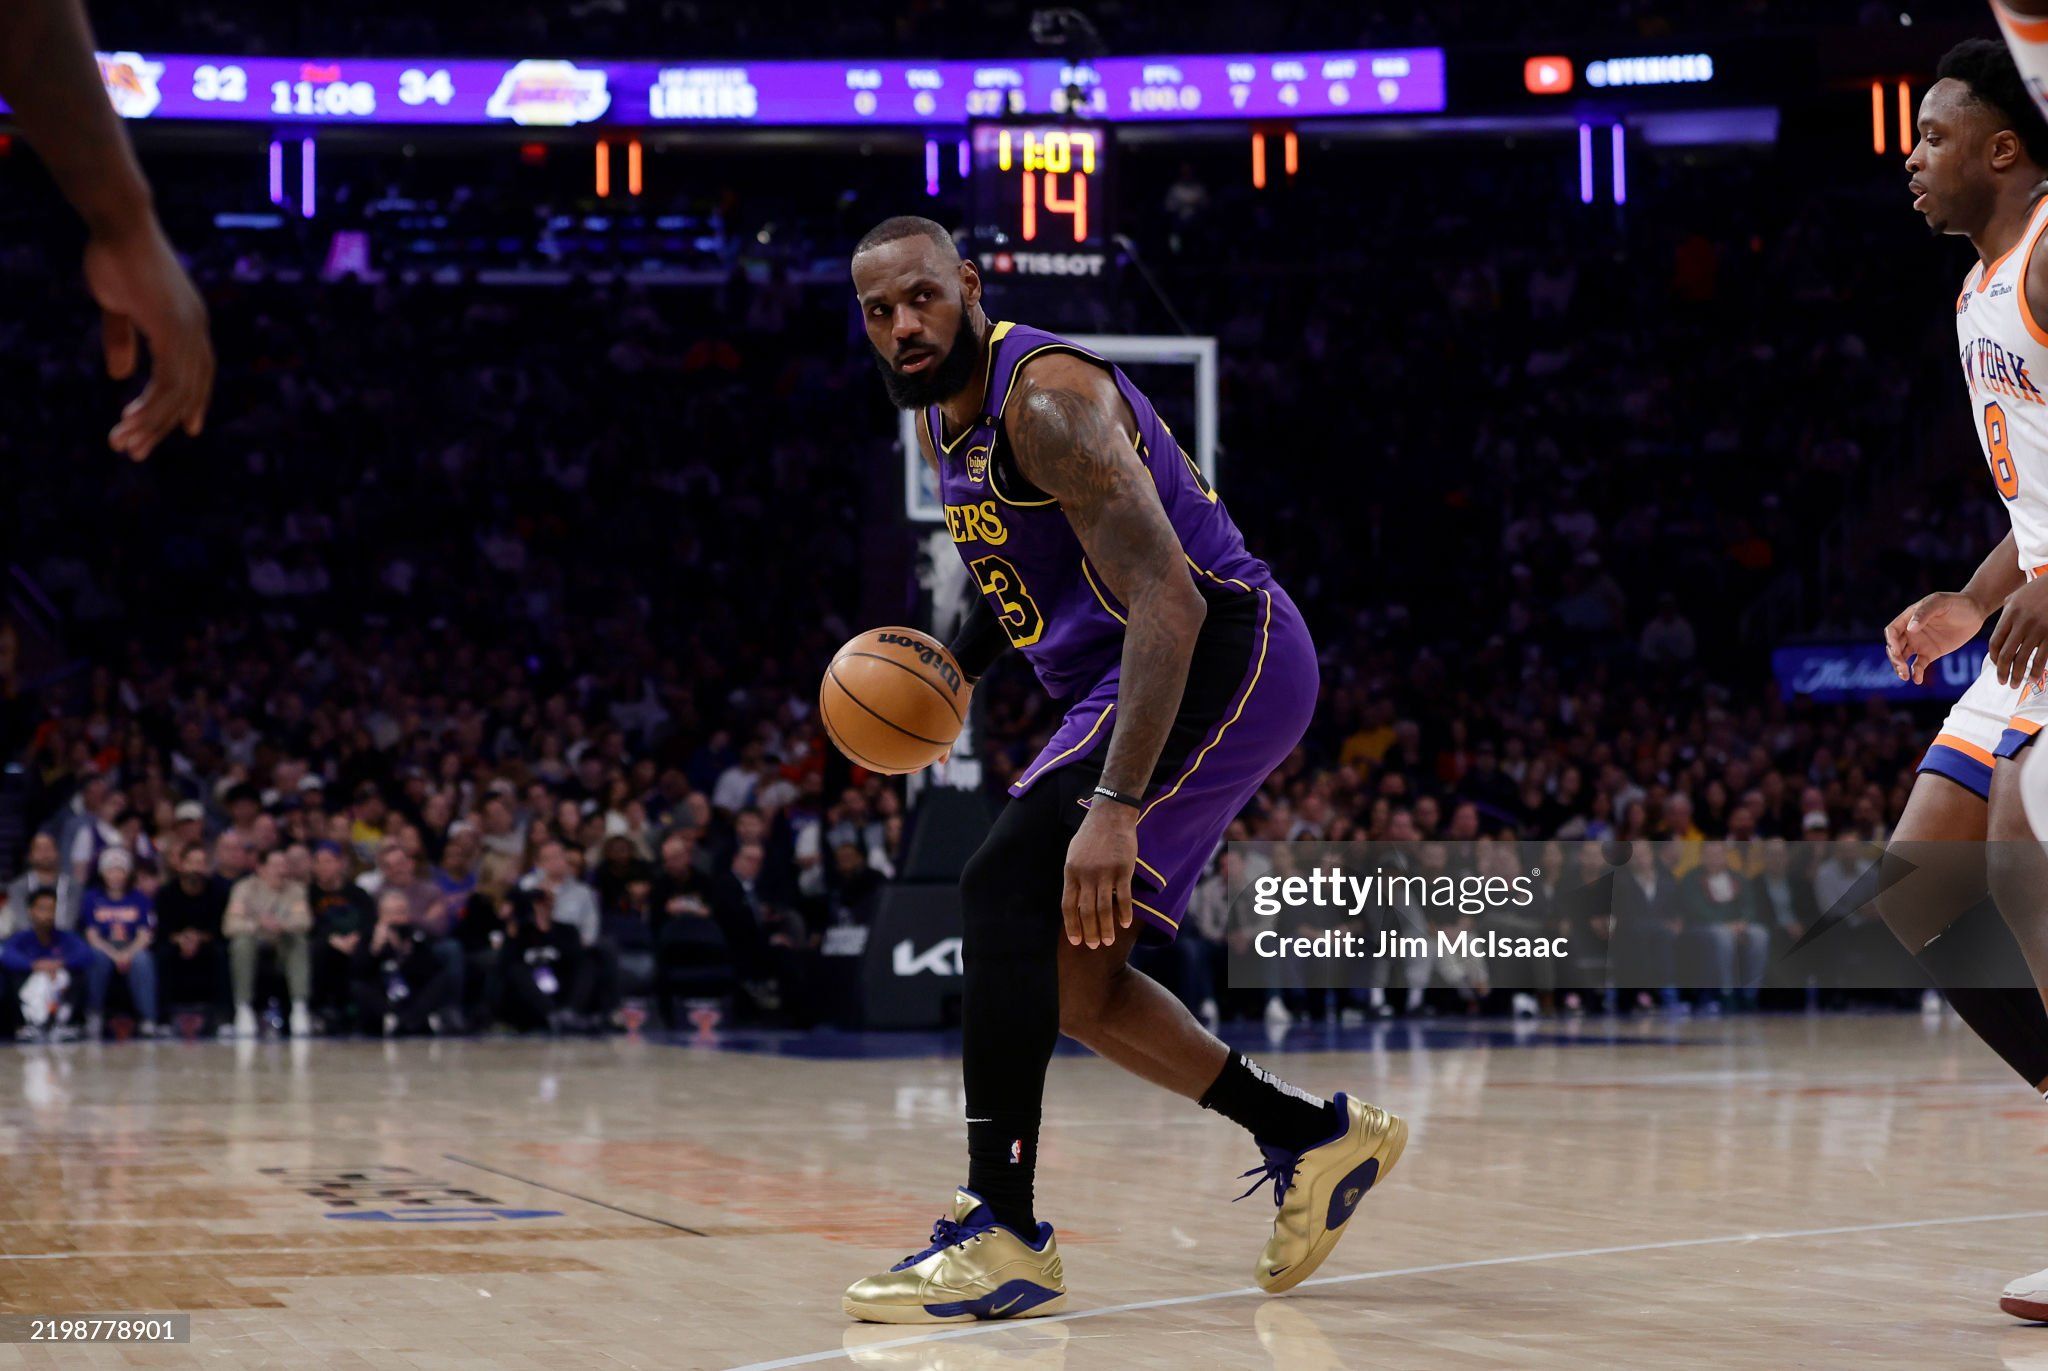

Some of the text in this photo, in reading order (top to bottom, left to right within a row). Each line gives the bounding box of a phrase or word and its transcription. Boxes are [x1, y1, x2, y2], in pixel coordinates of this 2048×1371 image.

[193, 65, 246, 101] 32
[398, 69, 455, 105] 34
[1229, 84, 1250, 108] 7
[999, 130, 1095, 174] 11:07
[1022, 170, 1087, 242] 14
[1013, 253, 1105, 276] TISSOT
[1977, 338, 2043, 402] YORK
[1984, 401, 2019, 502] 8
[970, 554, 1044, 649] 3
[878, 633, 961, 696] Wilson
